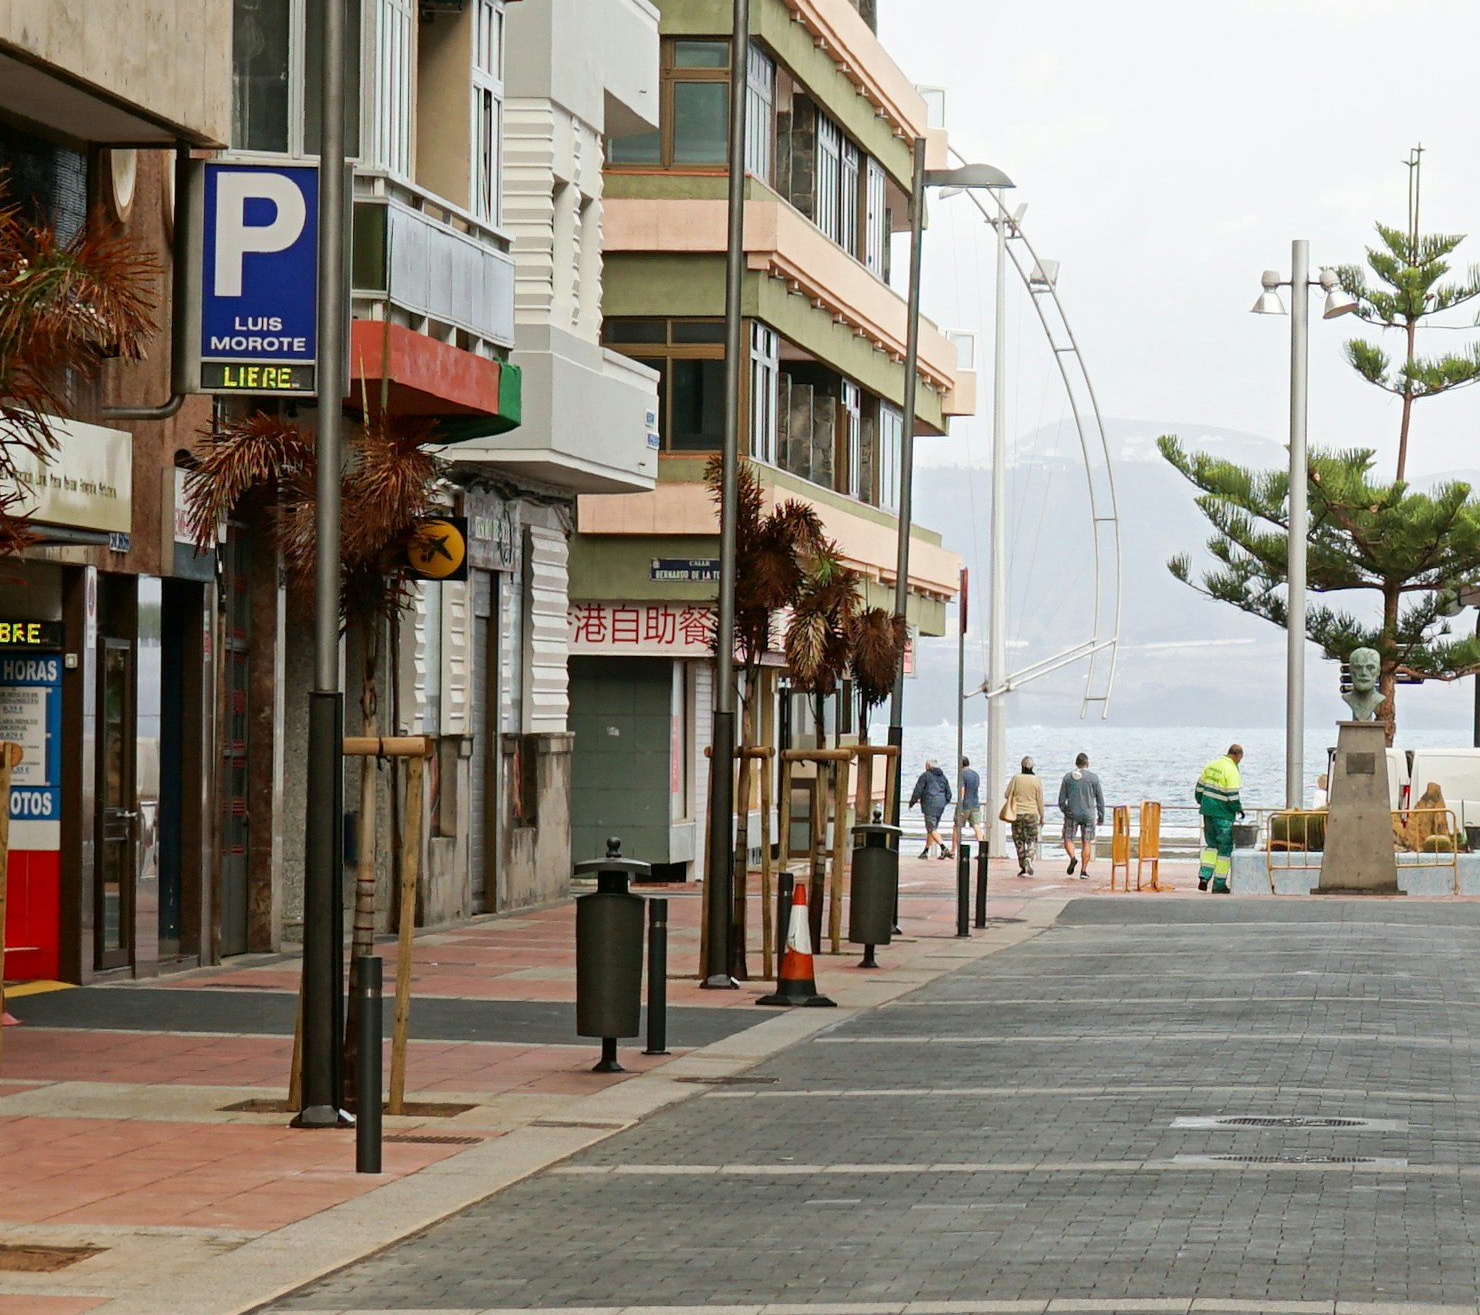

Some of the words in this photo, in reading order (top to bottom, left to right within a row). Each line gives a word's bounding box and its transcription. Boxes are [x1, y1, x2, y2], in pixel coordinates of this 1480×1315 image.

[214, 172, 306, 297] P
[234, 316, 282, 331] LUIS
[210, 336, 307, 352] MOROTE
[691, 570, 701, 580] DE
[702, 570, 711, 580] LA
[568, 603, 717, 646] 港自助餐
[3, 660, 58, 682] HORAS
[9, 791, 53, 815] OTOS
